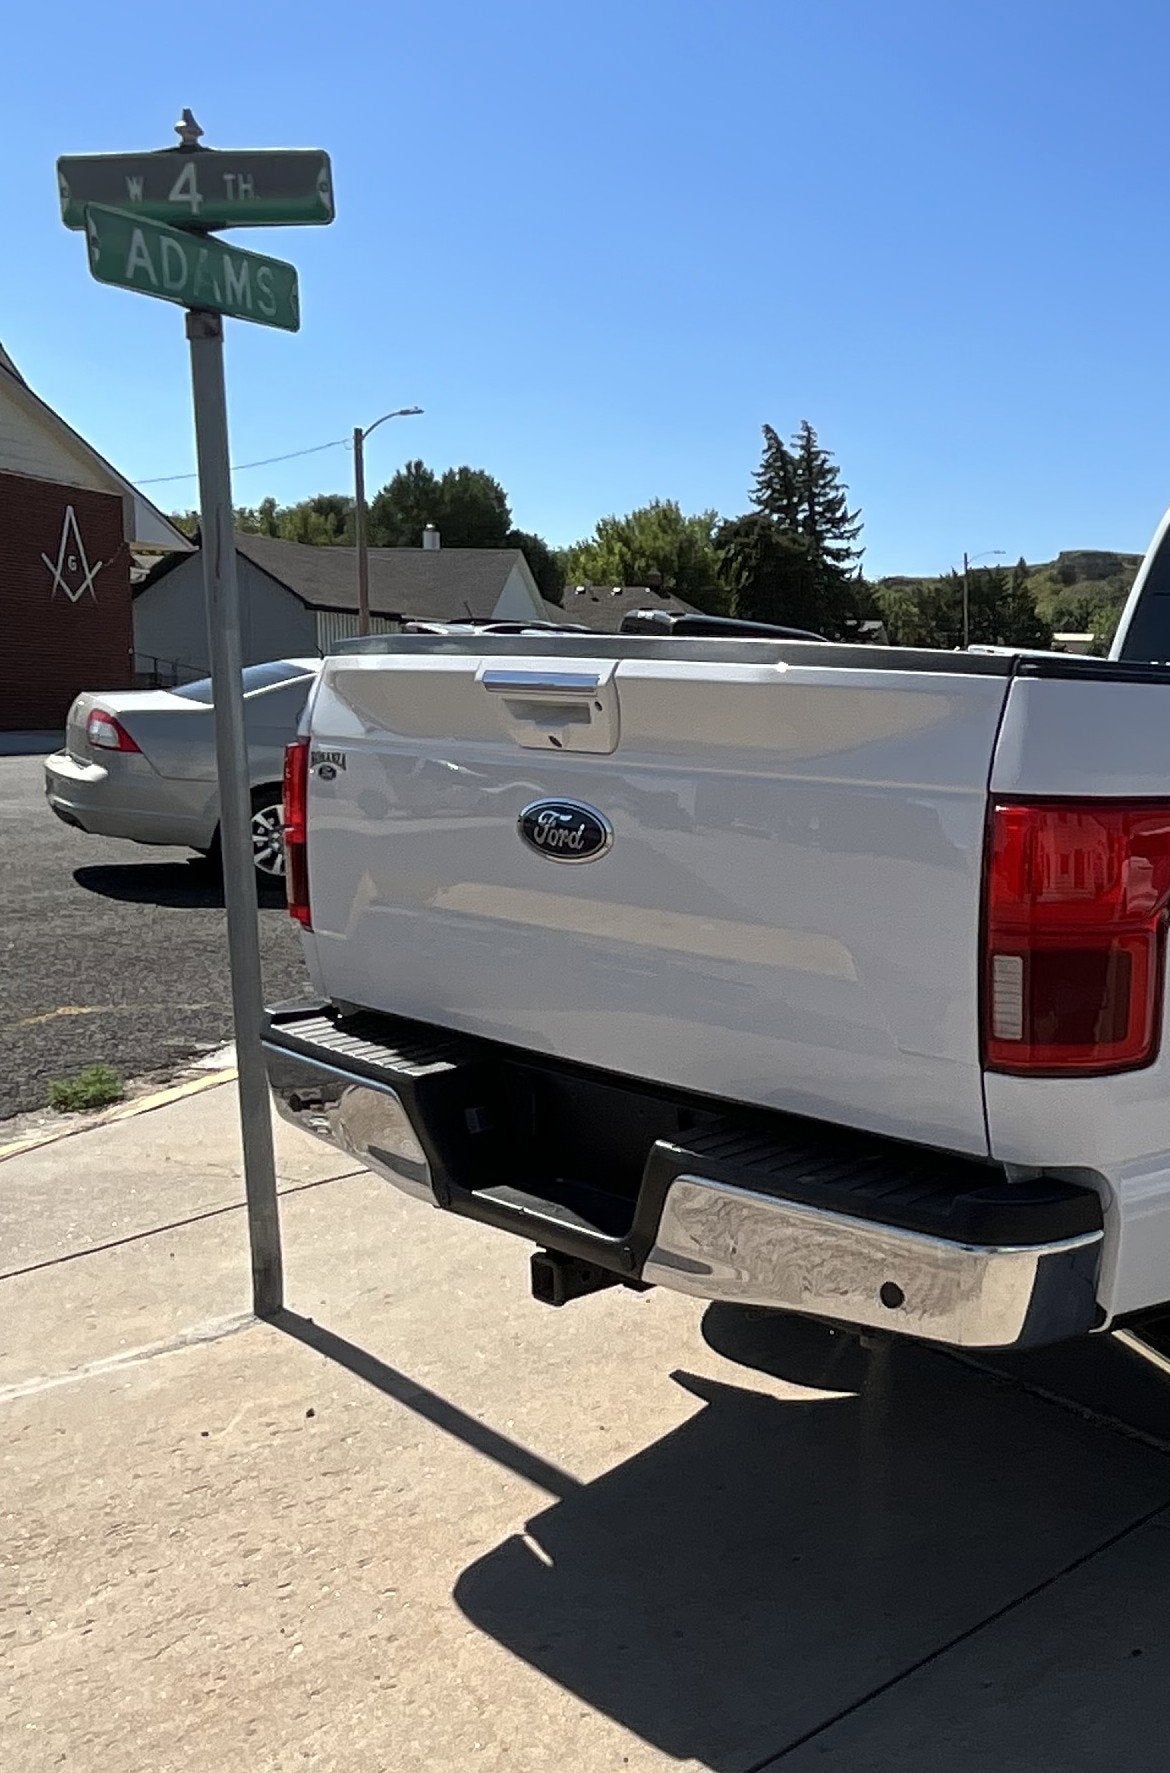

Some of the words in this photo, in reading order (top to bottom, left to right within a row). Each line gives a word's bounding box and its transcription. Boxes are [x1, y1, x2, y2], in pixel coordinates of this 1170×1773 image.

[125, 175, 144, 201] W
[168, 161, 204, 215] 4
[222, 172, 255, 201] TH
[124, 227, 278, 317] ADAMS
[67, 555, 78, 571] G
[533, 810, 585, 850] Ford
